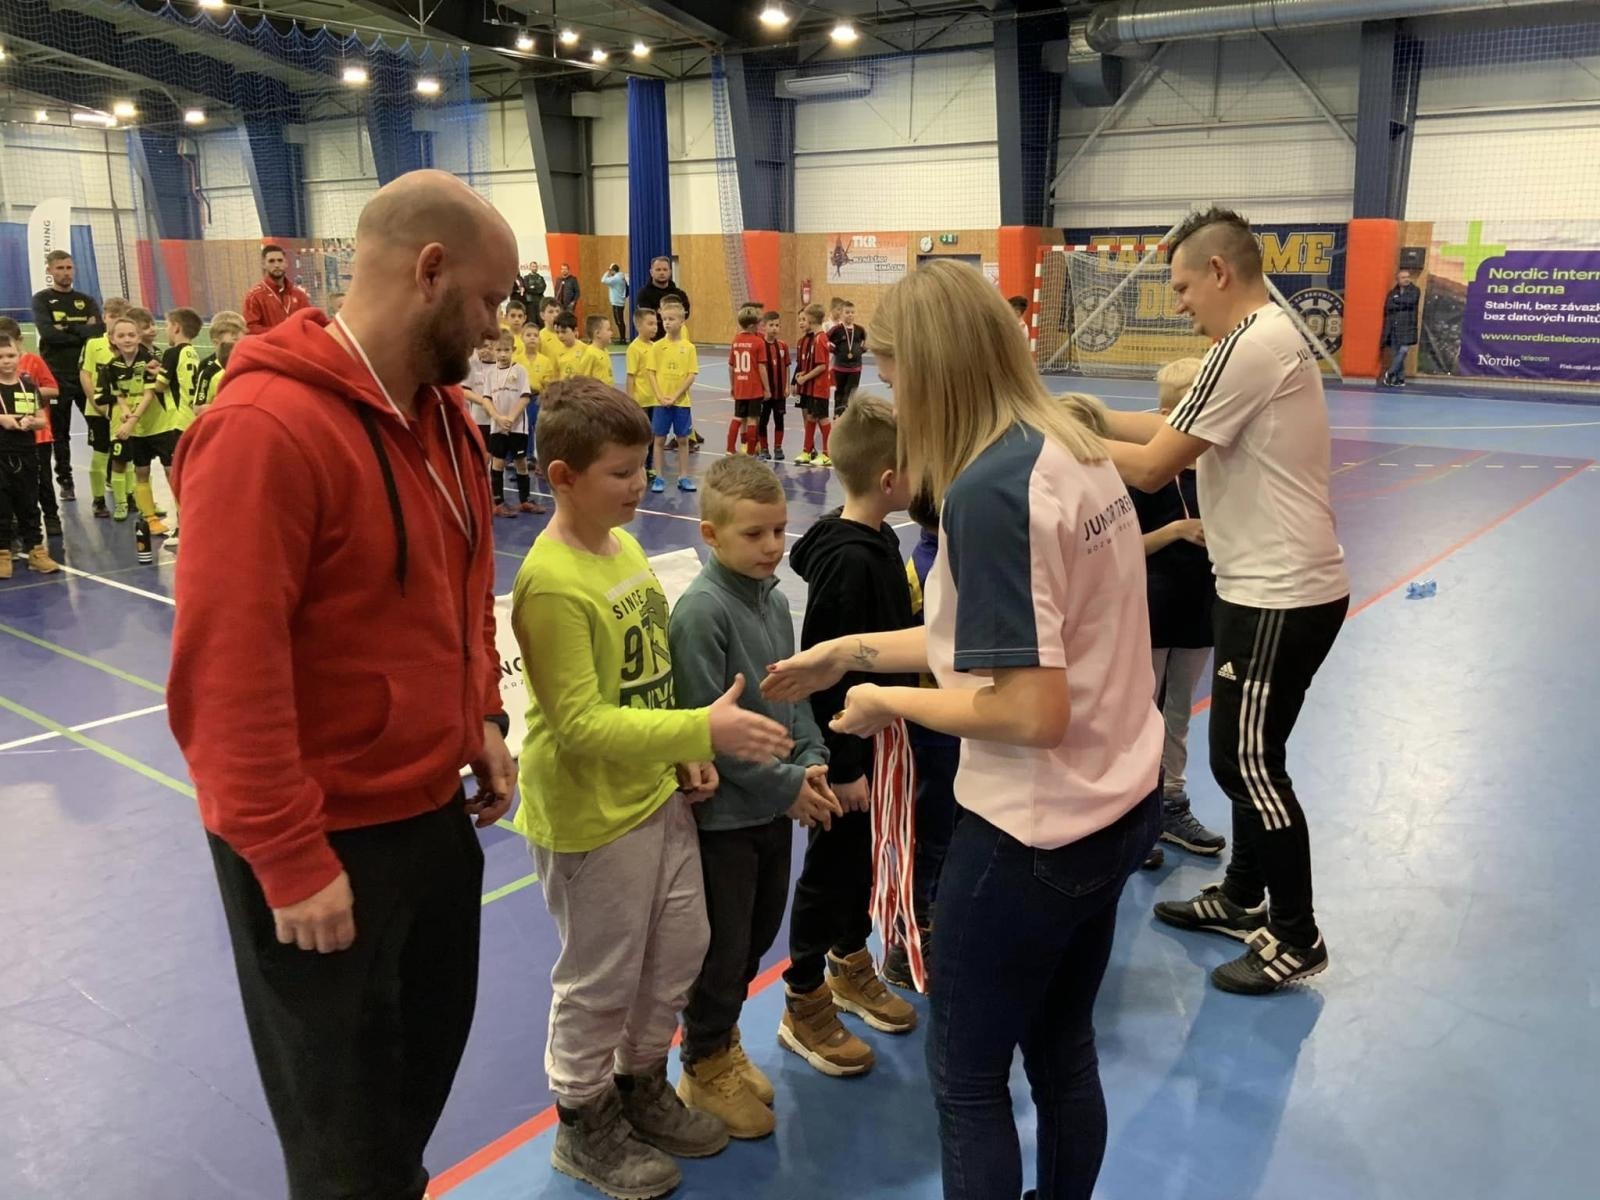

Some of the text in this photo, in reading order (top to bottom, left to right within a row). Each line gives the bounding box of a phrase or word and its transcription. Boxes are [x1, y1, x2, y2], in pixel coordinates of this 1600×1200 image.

[1488, 268, 1549, 279] Nordic
[1487, 282, 1565, 294] na doma
[1484, 301, 1532, 311] Stabilní,
[1535, 302, 1557, 310] bez
[1483, 312, 1506, 320] bez
[1507, 312, 1565, 323] datových
[733, 351, 751, 374] 10
[1478, 353, 1520, 367] Nordic
[113, 443, 122, 456] 9
[612, 589, 644, 620] SINCE
